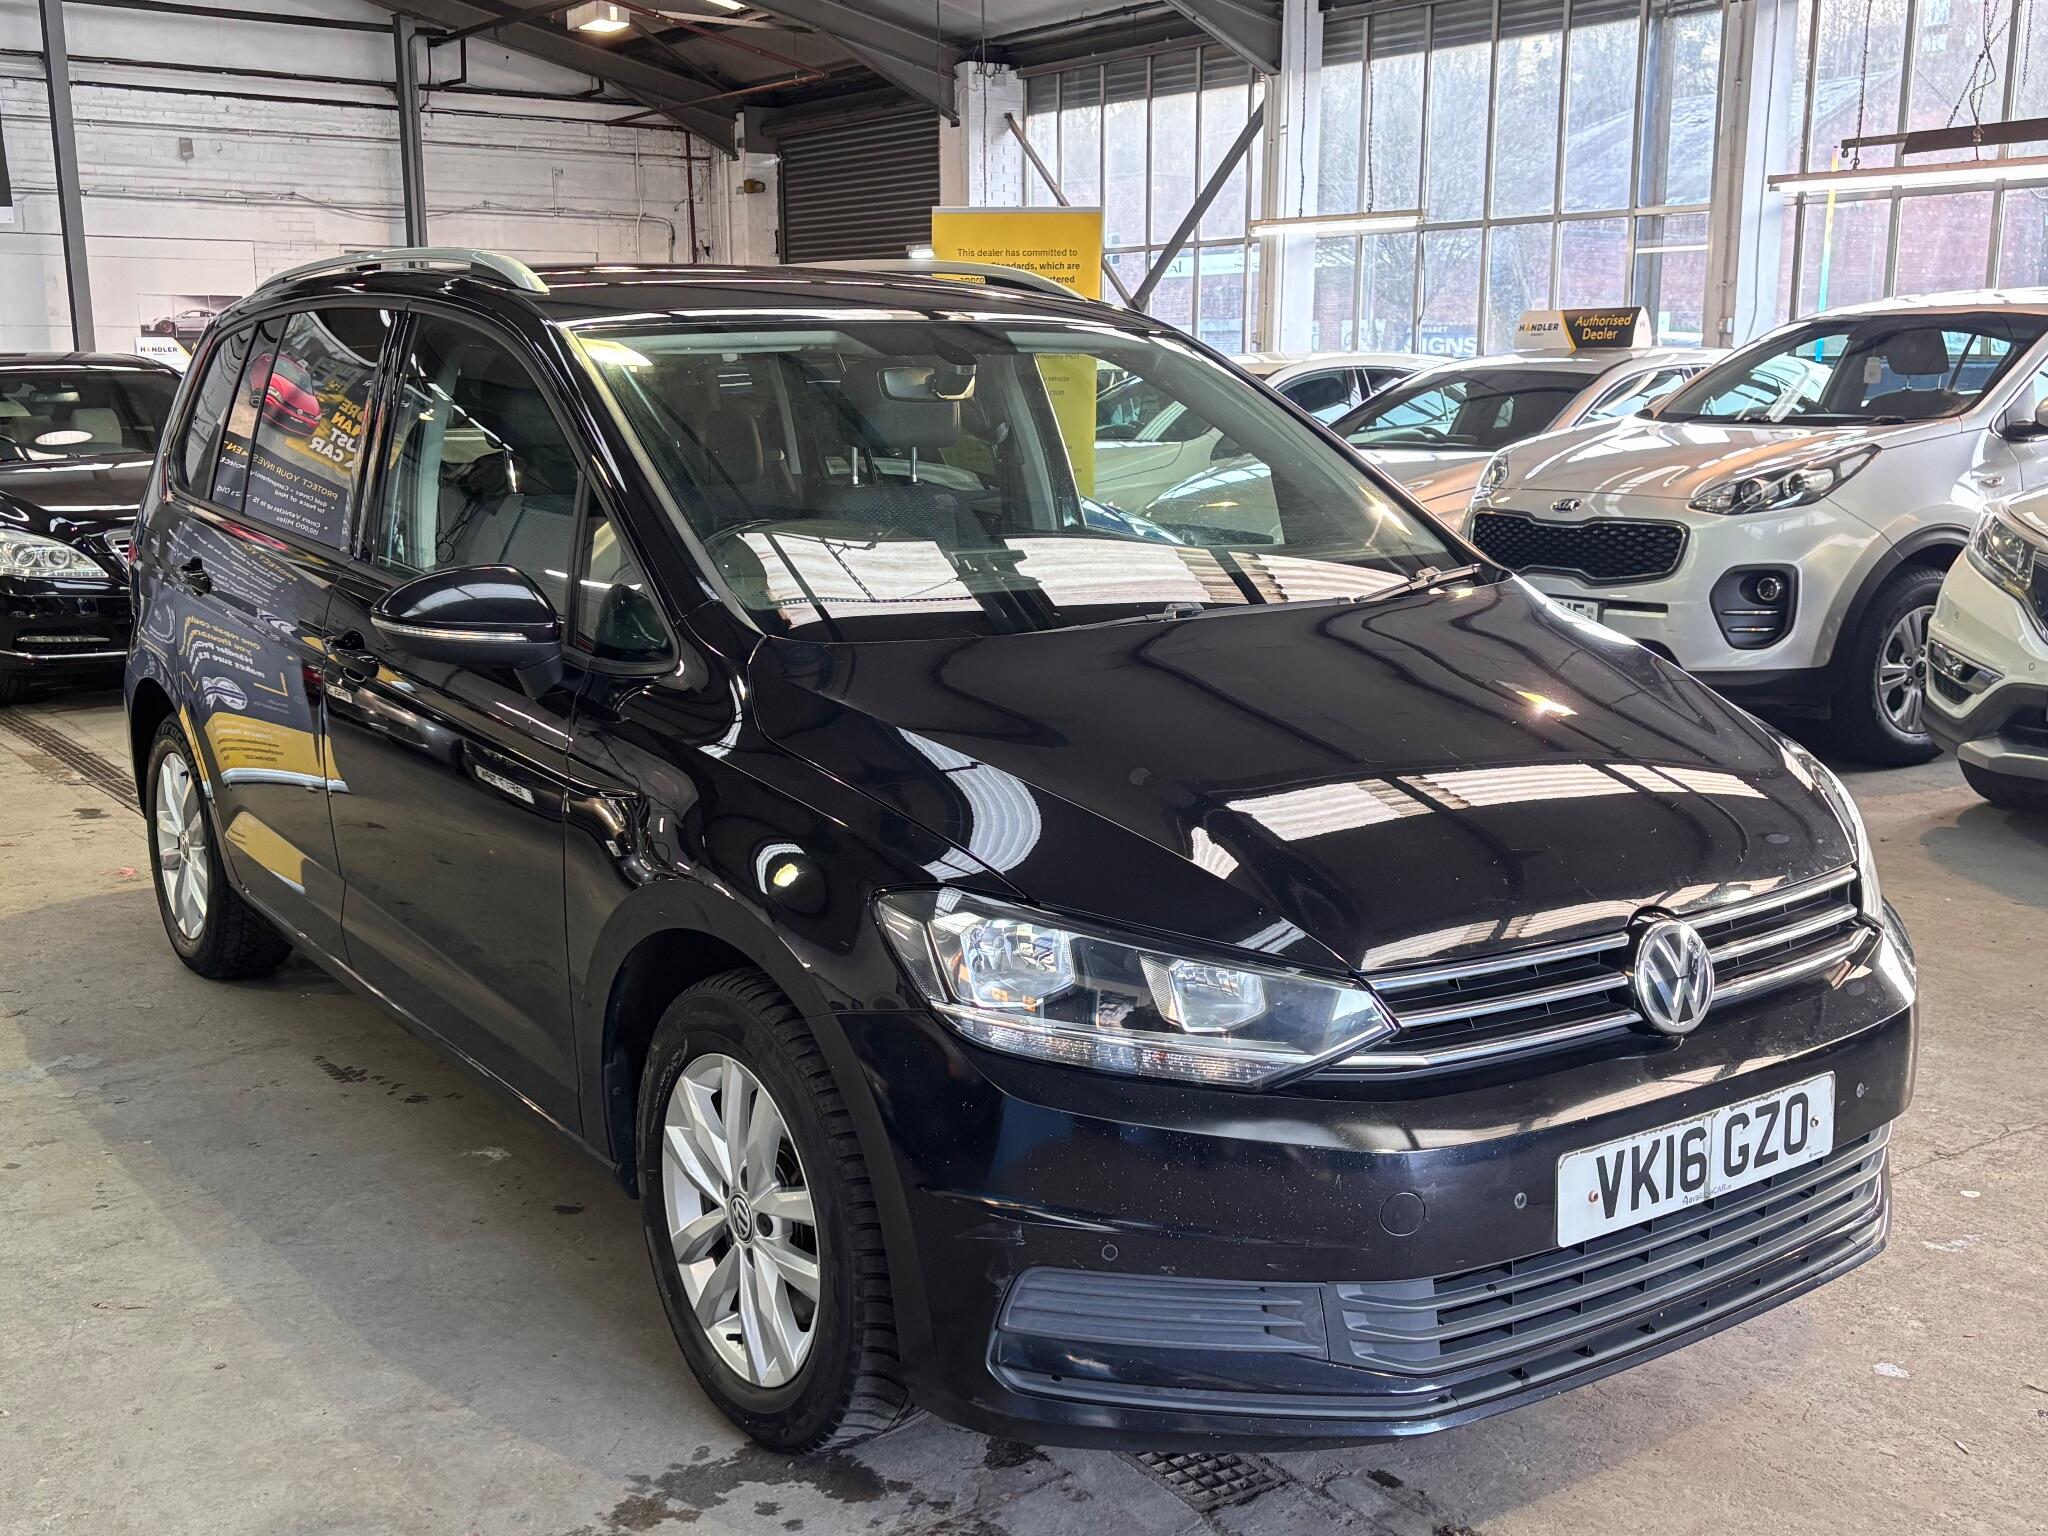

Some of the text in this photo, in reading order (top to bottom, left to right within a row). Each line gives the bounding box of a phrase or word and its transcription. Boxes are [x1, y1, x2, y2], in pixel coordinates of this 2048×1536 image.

[957, 248, 1078, 257] This dealer has committed to
[1039, 261, 1066, 270] which
[1575, 313, 1633, 327] Authorised
[1582, 328, 1619, 340] Dealer
[1595, 1092, 1810, 1220] VK16 GZO
